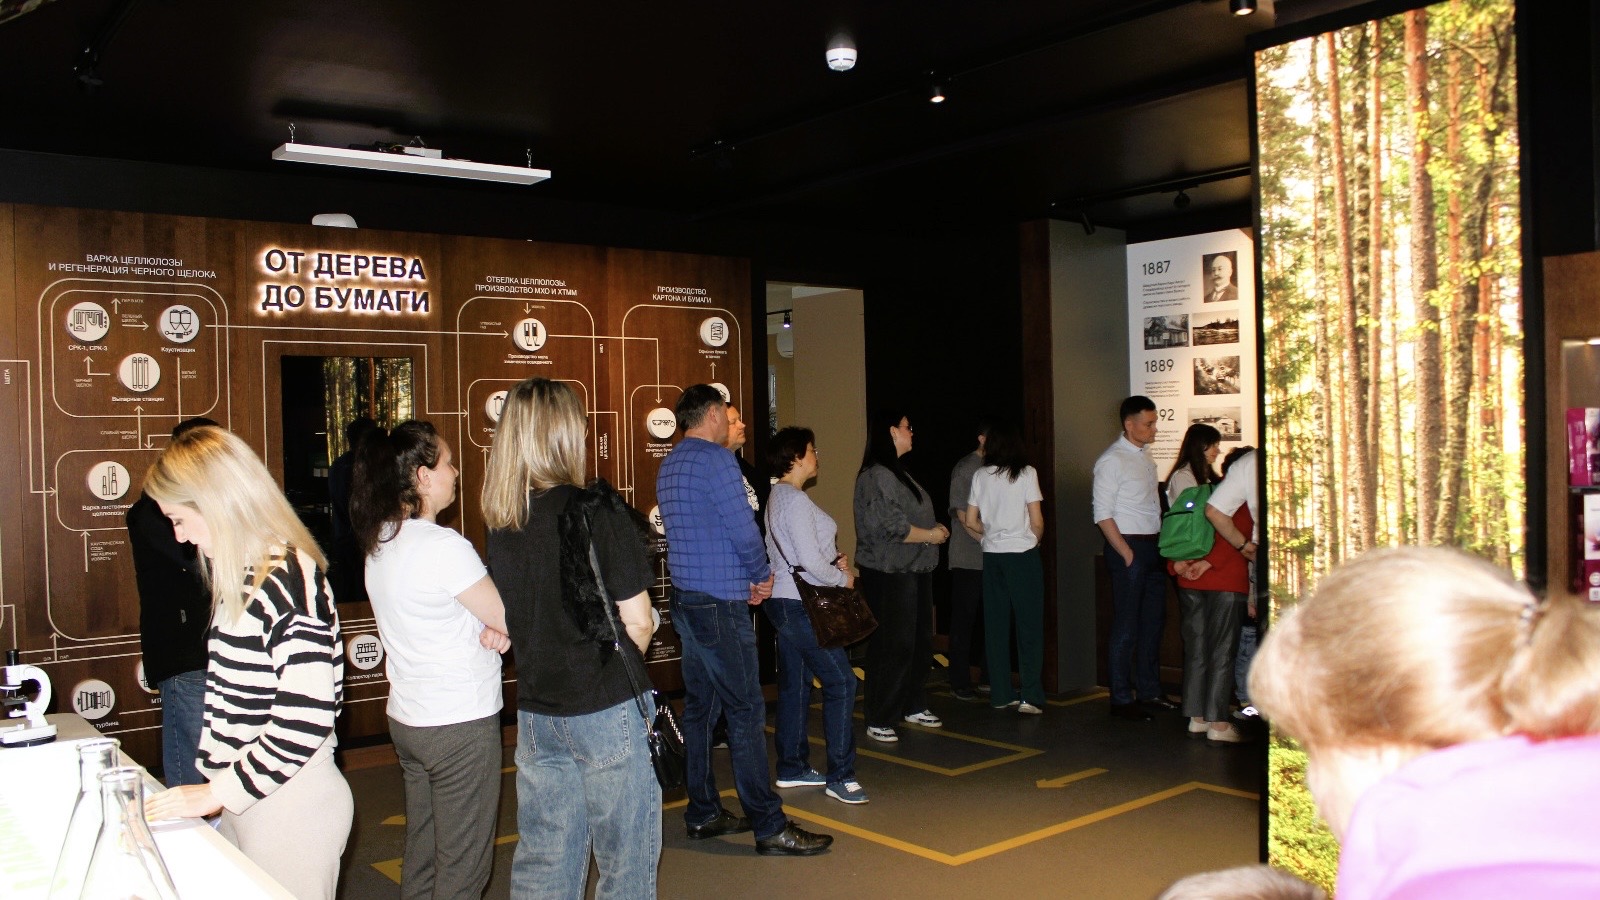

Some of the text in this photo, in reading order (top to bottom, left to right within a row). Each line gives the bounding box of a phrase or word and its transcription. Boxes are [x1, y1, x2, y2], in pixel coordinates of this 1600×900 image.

[86, 254, 183, 267] ВАРКА ЦЕЛЛЮЛОЗЫ
[265, 248, 426, 280] ОТ ДЕРЕВА
[48, 263, 217, 279] И РЕГЕНЕРАЦИЯ ЧЕРНОГО ЩЕЛОКА
[1142, 260, 1171, 276] 1887
[486, 275, 519, 285] ОТБЕЛКА
[474, 284, 534, 294] ПРОИЗВОДСТВО
[534, 286, 550, 295] МХО
[557, 288, 578, 296] ХТММ
[657, 285, 707, 295] ПРОИЗВОДСТВО
[261, 284, 430, 313] ДО БУМАГИ
[652, 293, 681, 302] КАРТОНА
[687, 295, 712, 304] БУМАГИ
[1144, 358, 1175, 373] 1889
[1159, 408, 1175, 421] 92
[82, 504, 100, 512] Варка
[96, 720, 119, 730] турбина
